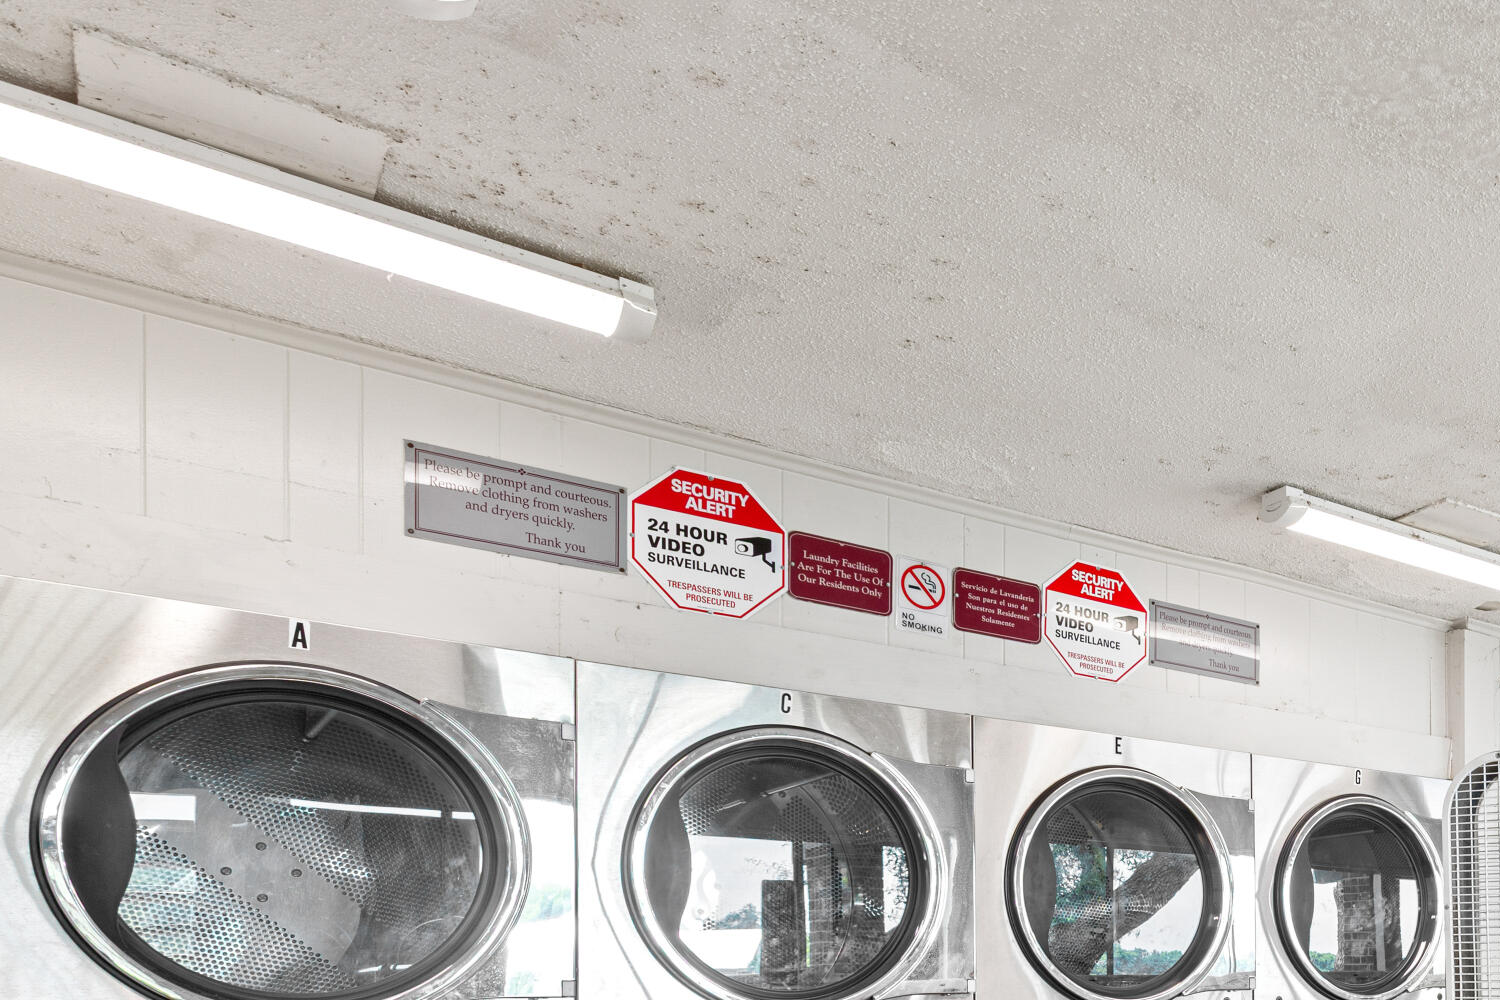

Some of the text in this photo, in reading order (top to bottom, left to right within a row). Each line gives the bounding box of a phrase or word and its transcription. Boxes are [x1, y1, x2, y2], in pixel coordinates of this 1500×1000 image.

[424, 458, 612, 508] Please be prompt and courteous.
[671, 478, 749, 507] SECURITY
[429, 475, 608, 522] Remove clothing from washers
[685, 497, 736, 518] ALERT
[465, 500, 576, 532] and dryers quickly.
[648, 518, 728, 545] 24 HOUR
[525, 532, 586, 554] Thank you
[648, 534, 705, 557] VIDEO
[648, 552, 746, 579] SURVEILLANCE
[803, 550, 878, 574] Laundry Facilities
[797, 561, 884, 587] Are For The Use Of
[1071, 569, 1124, 592] SECURITY
[667, 580, 753, 602] TRESPASSERS WILL BE
[798, 573, 883, 599] Our Residents Only
[961, 581, 988, 592] Servicio
[1080, 584, 1115, 601] ALERT
[686, 593, 736, 609] PROSECUTED
[968, 593, 981, 601] Son
[983, 597, 997, 605] para
[902, 612, 915, 621] NO
[966, 602, 1030, 621] Nuestros Residentes
[981, 615, 1015, 628] Solamente
[1055, 602, 1109, 623] 24 HOUR
[1160, 611, 1179, 622] Please
[1180, 616, 1187, 624] be
[901, 620, 943, 634] SMOKING
[1055, 615, 1094, 633] VIDEO
[292, 622, 307, 648] A
[1055, 629, 1121, 650] SURVEILLANCE
[1067, 651, 1104, 665] TRESPASSERS
[1105, 659, 1117, 667] WILL
[1079, 662, 1114, 675] PROSECUTED
[1209, 658, 1239, 672] Thank you
[781, 692, 791, 714] C
[1115, 736, 1122, 755] E
[1355, 769, 1361, 785] G
